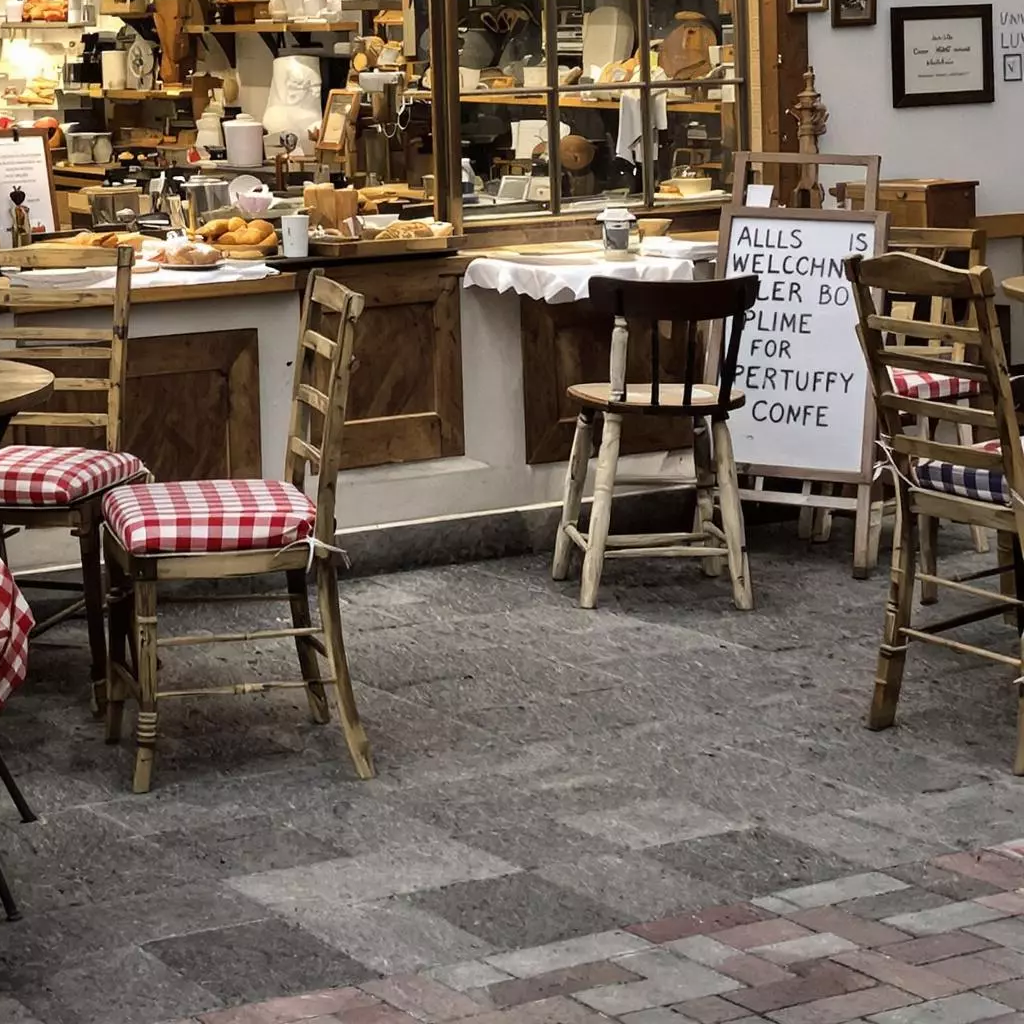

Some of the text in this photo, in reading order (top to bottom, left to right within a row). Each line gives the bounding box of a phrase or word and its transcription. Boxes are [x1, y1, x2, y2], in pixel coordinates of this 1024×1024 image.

[737, 226, 869, 252] ALLLS IS
[750, 339, 791, 359] FOR
[751, 400, 829, 427] CONFE
